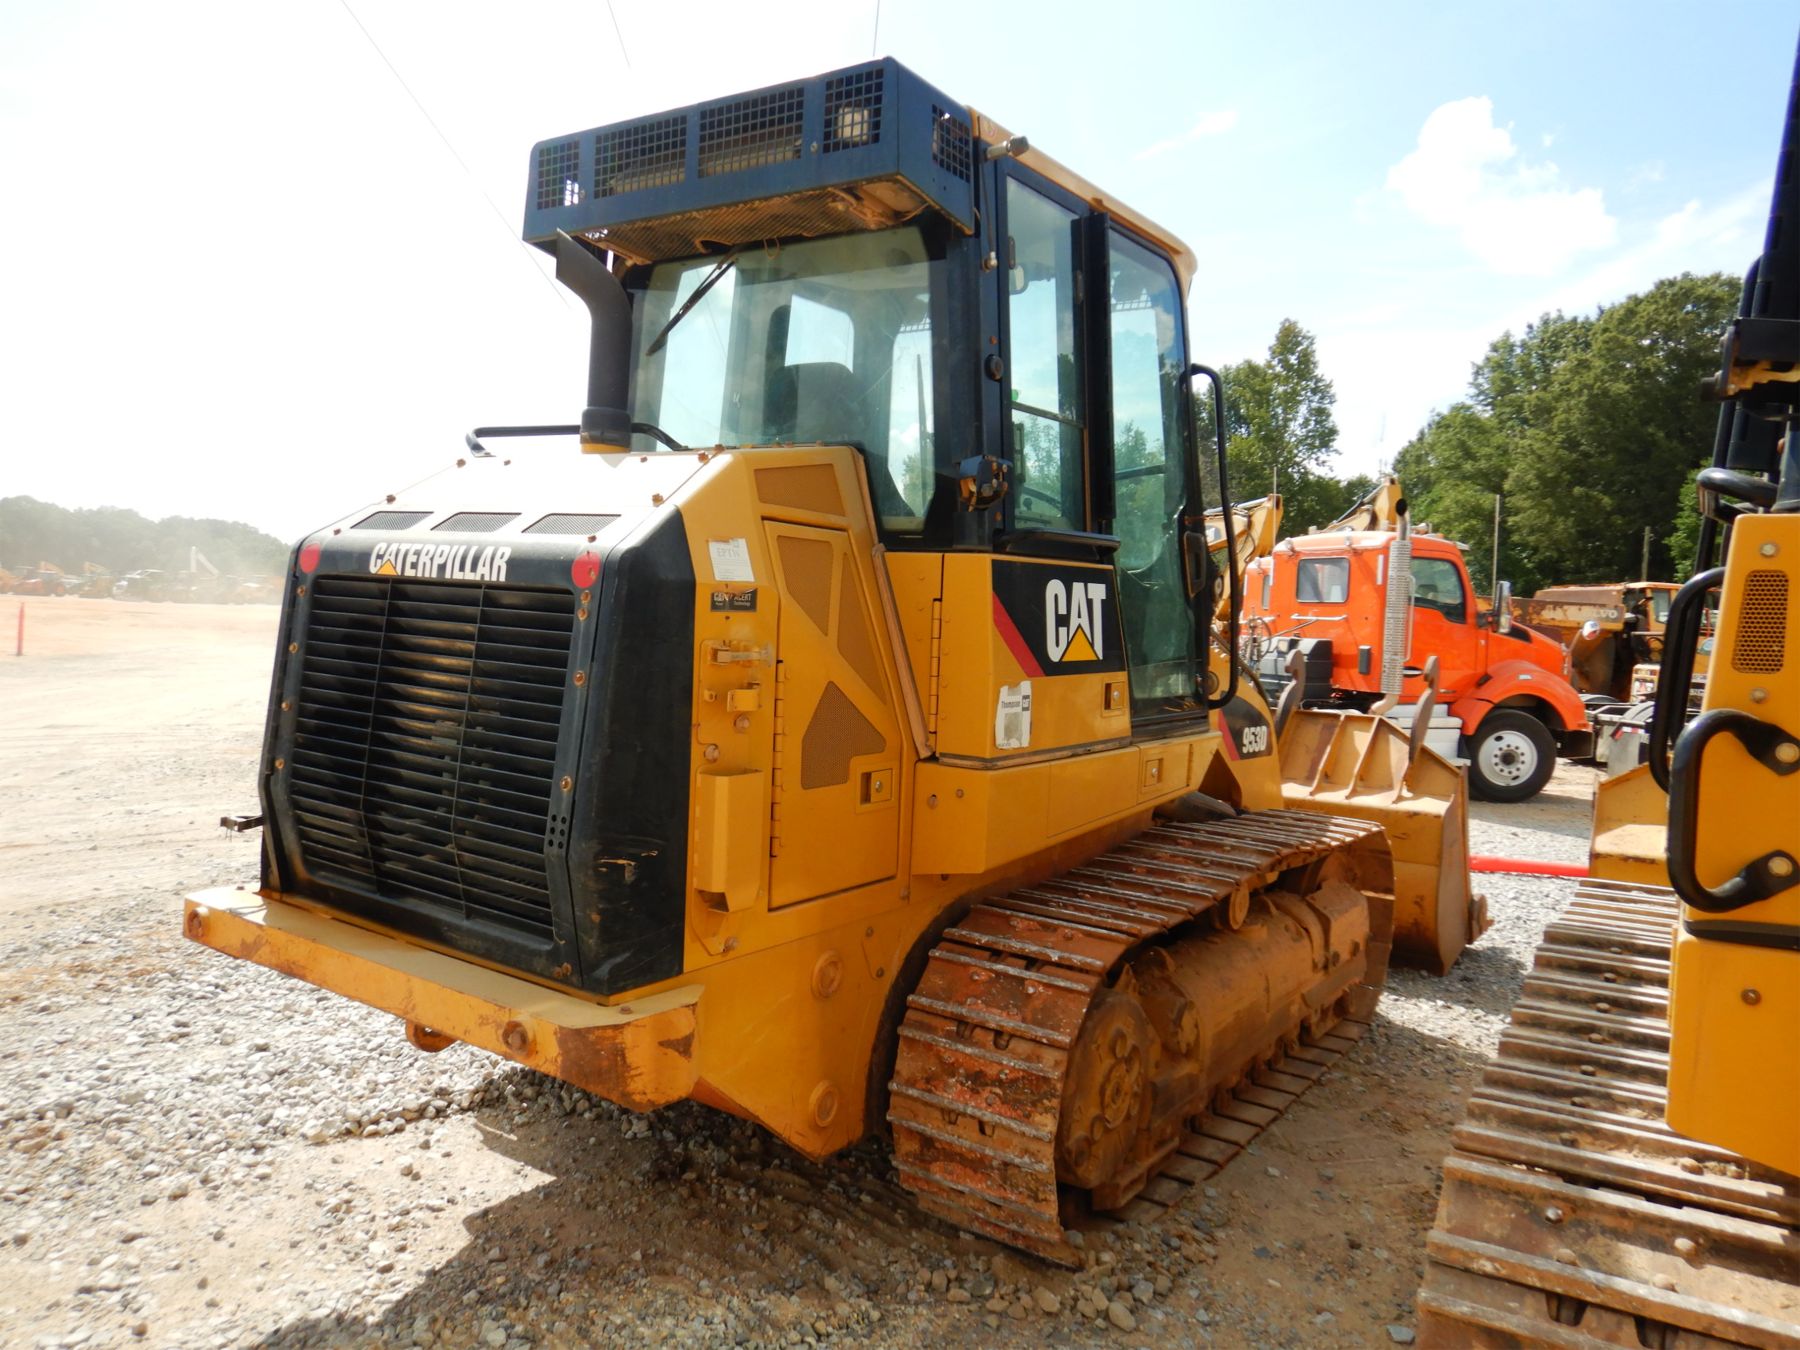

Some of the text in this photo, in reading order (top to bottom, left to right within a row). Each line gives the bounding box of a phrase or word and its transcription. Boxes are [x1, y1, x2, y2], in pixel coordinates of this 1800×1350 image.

[369, 542, 512, 582] CATERPILLAR
[1045, 579, 1106, 662] CAT
[1242, 725, 1267, 753] 953D
